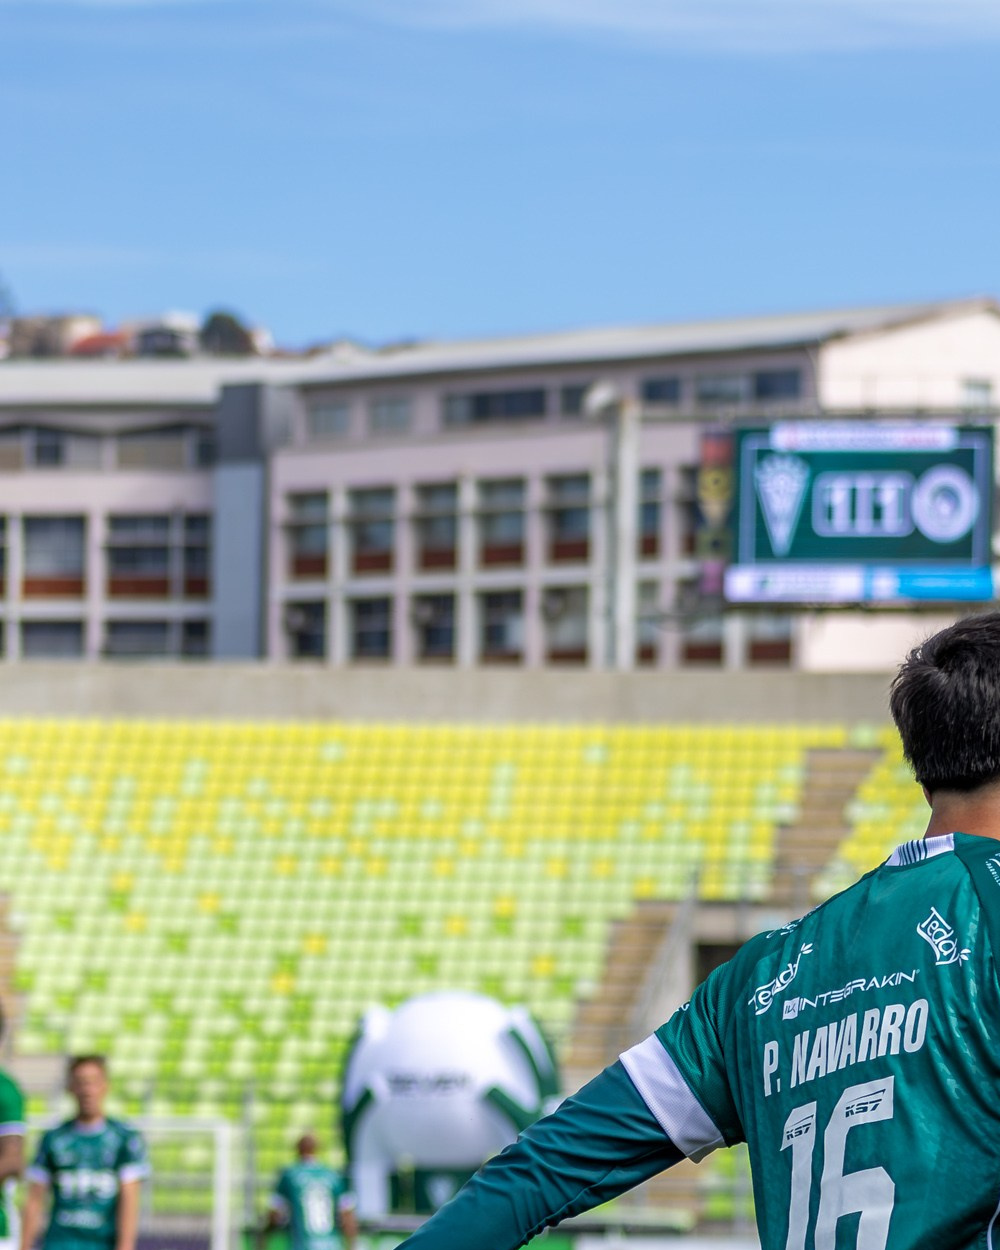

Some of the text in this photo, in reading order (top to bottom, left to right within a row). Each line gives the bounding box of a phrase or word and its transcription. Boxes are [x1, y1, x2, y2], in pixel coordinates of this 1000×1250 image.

[917, 906, 964, 966] Teddy
[799, 970, 916, 1011] INTEGRAKIN
[763, 998, 928, 1097] P. NAVARRO
